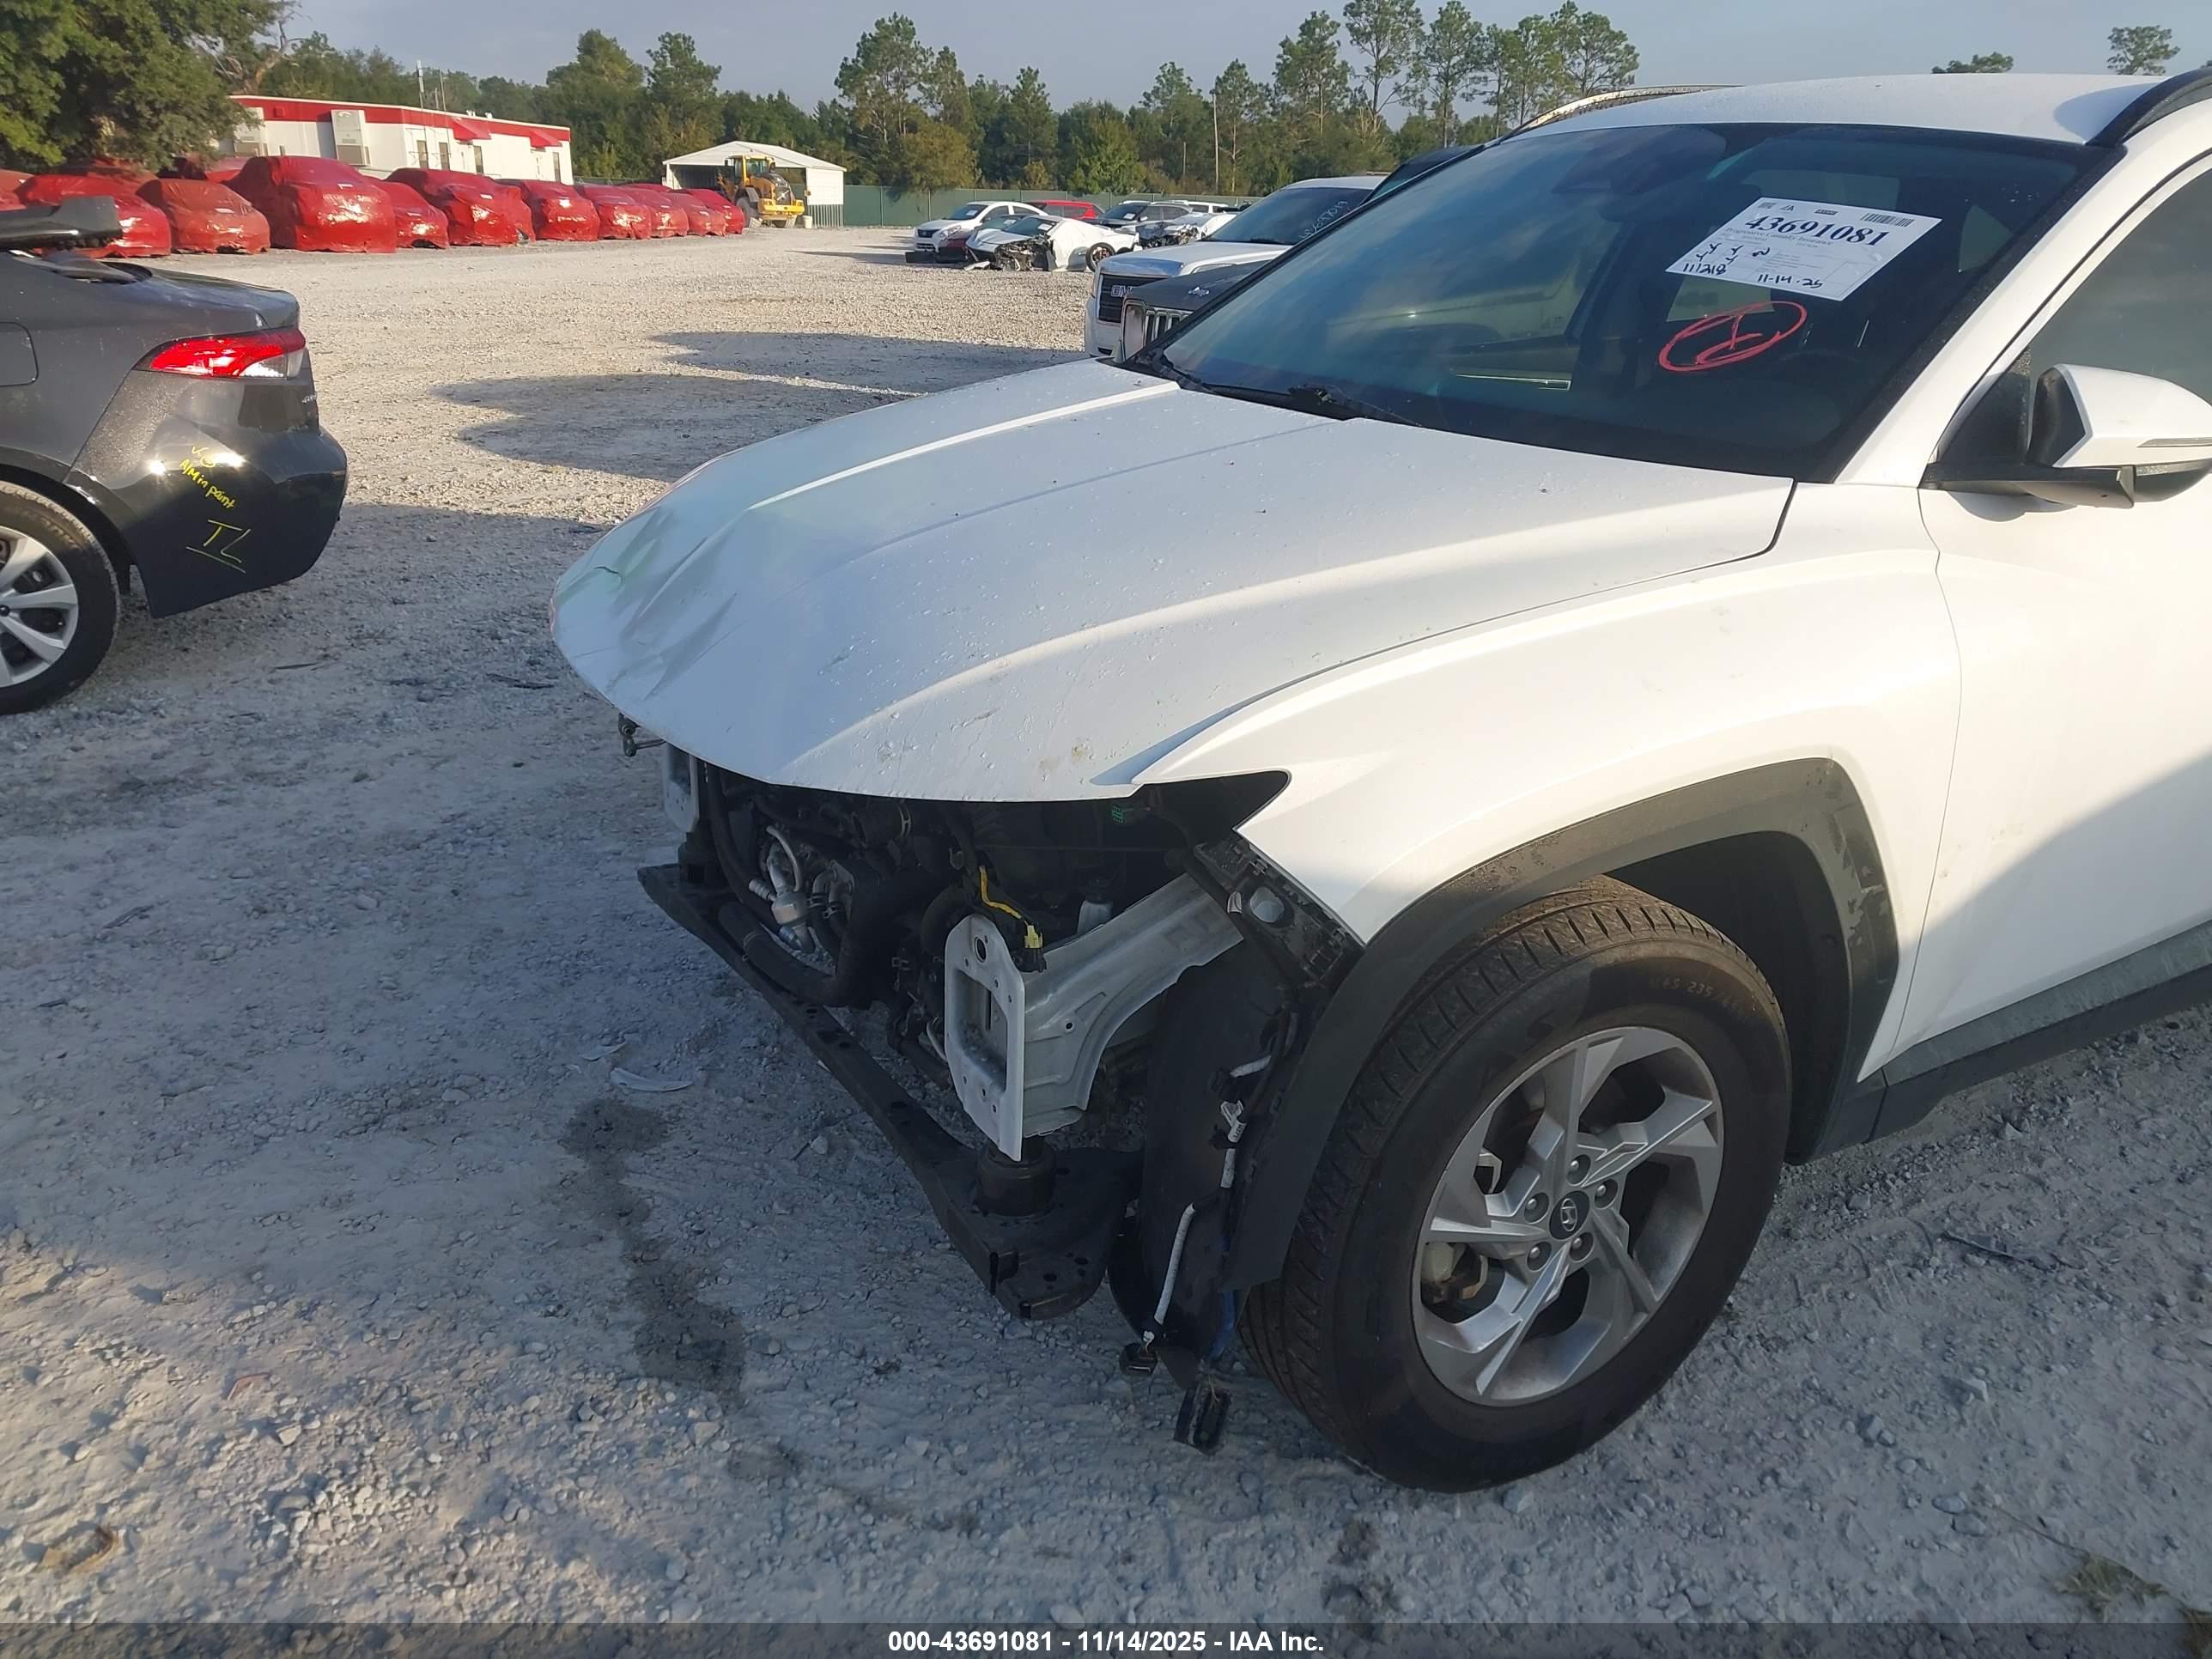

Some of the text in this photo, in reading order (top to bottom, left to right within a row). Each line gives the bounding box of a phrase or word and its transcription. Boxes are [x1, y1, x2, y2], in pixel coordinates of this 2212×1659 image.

[1745, 215, 1890, 246] 43691081
[1110, 285, 1133, 298] GM
[205, 485, 236, 509] paint
